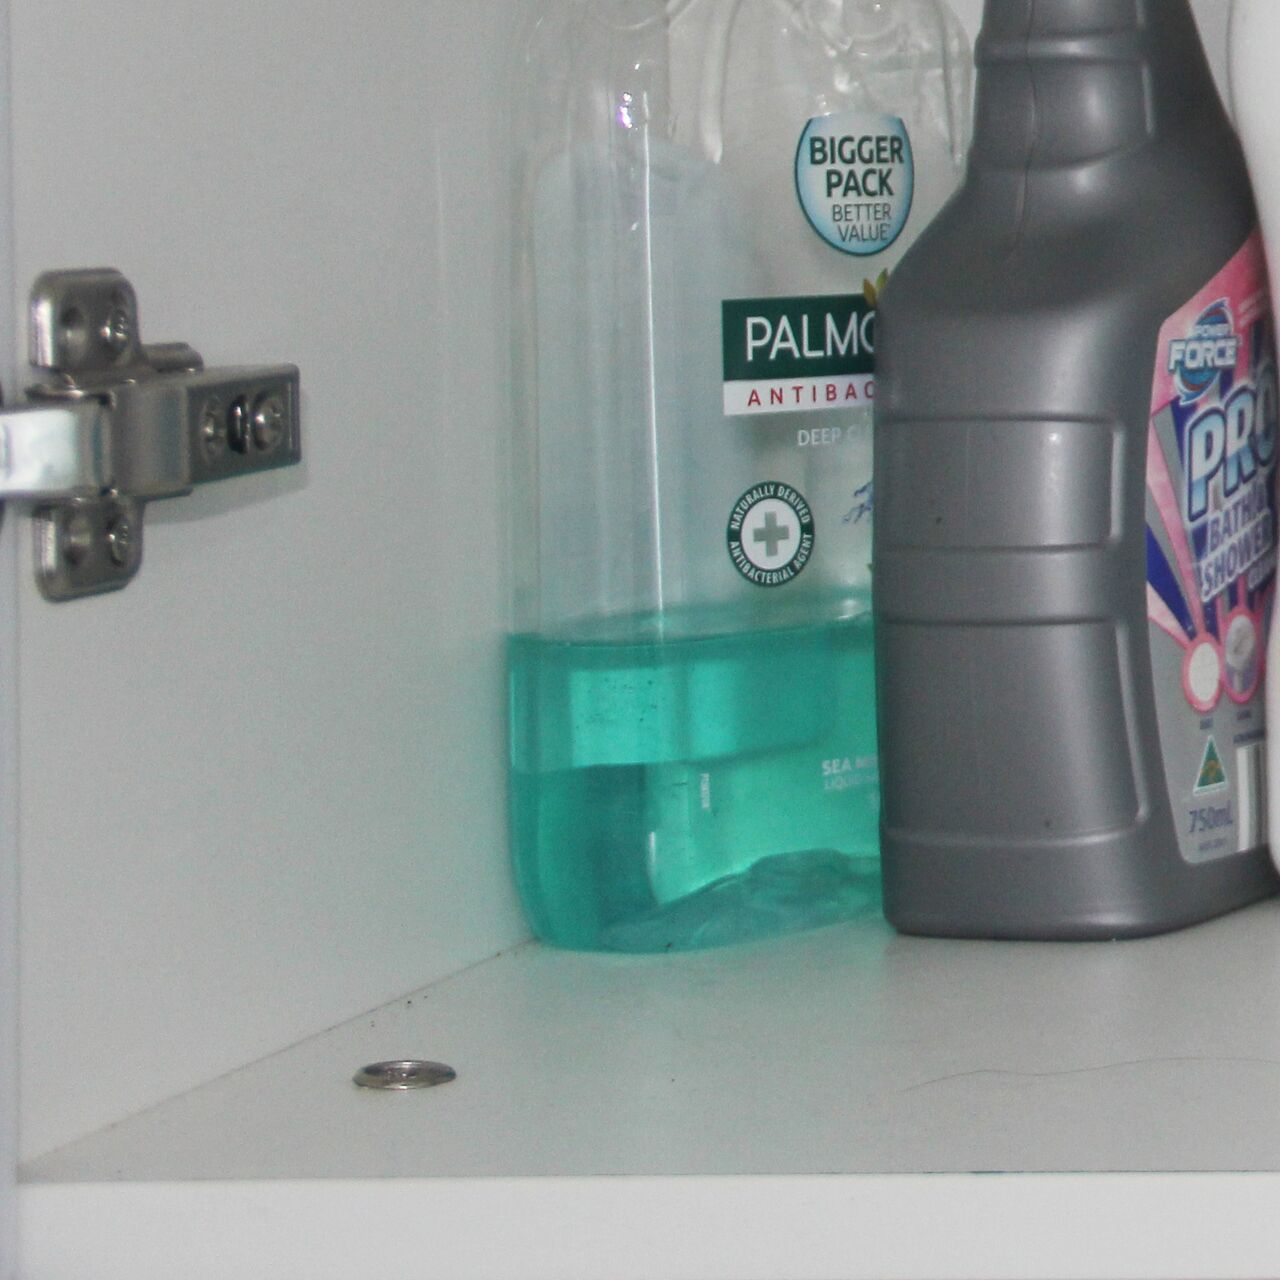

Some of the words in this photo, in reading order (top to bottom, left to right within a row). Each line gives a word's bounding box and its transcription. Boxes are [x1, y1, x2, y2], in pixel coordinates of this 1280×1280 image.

[809, 135, 904, 165] BIGGER
[826, 168, 894, 198] PACK
[832, 202, 892, 222] BETTER
[1169, 338, 1237, 371] FORCE
[797, 427, 841, 447] DEEP
[730, 484, 775, 529] NATURALLY
[777, 485, 811, 524] DERIVED
[730, 541, 795, 584] ANTIBACTERIAL
[793, 532, 813, 569] AGENT
